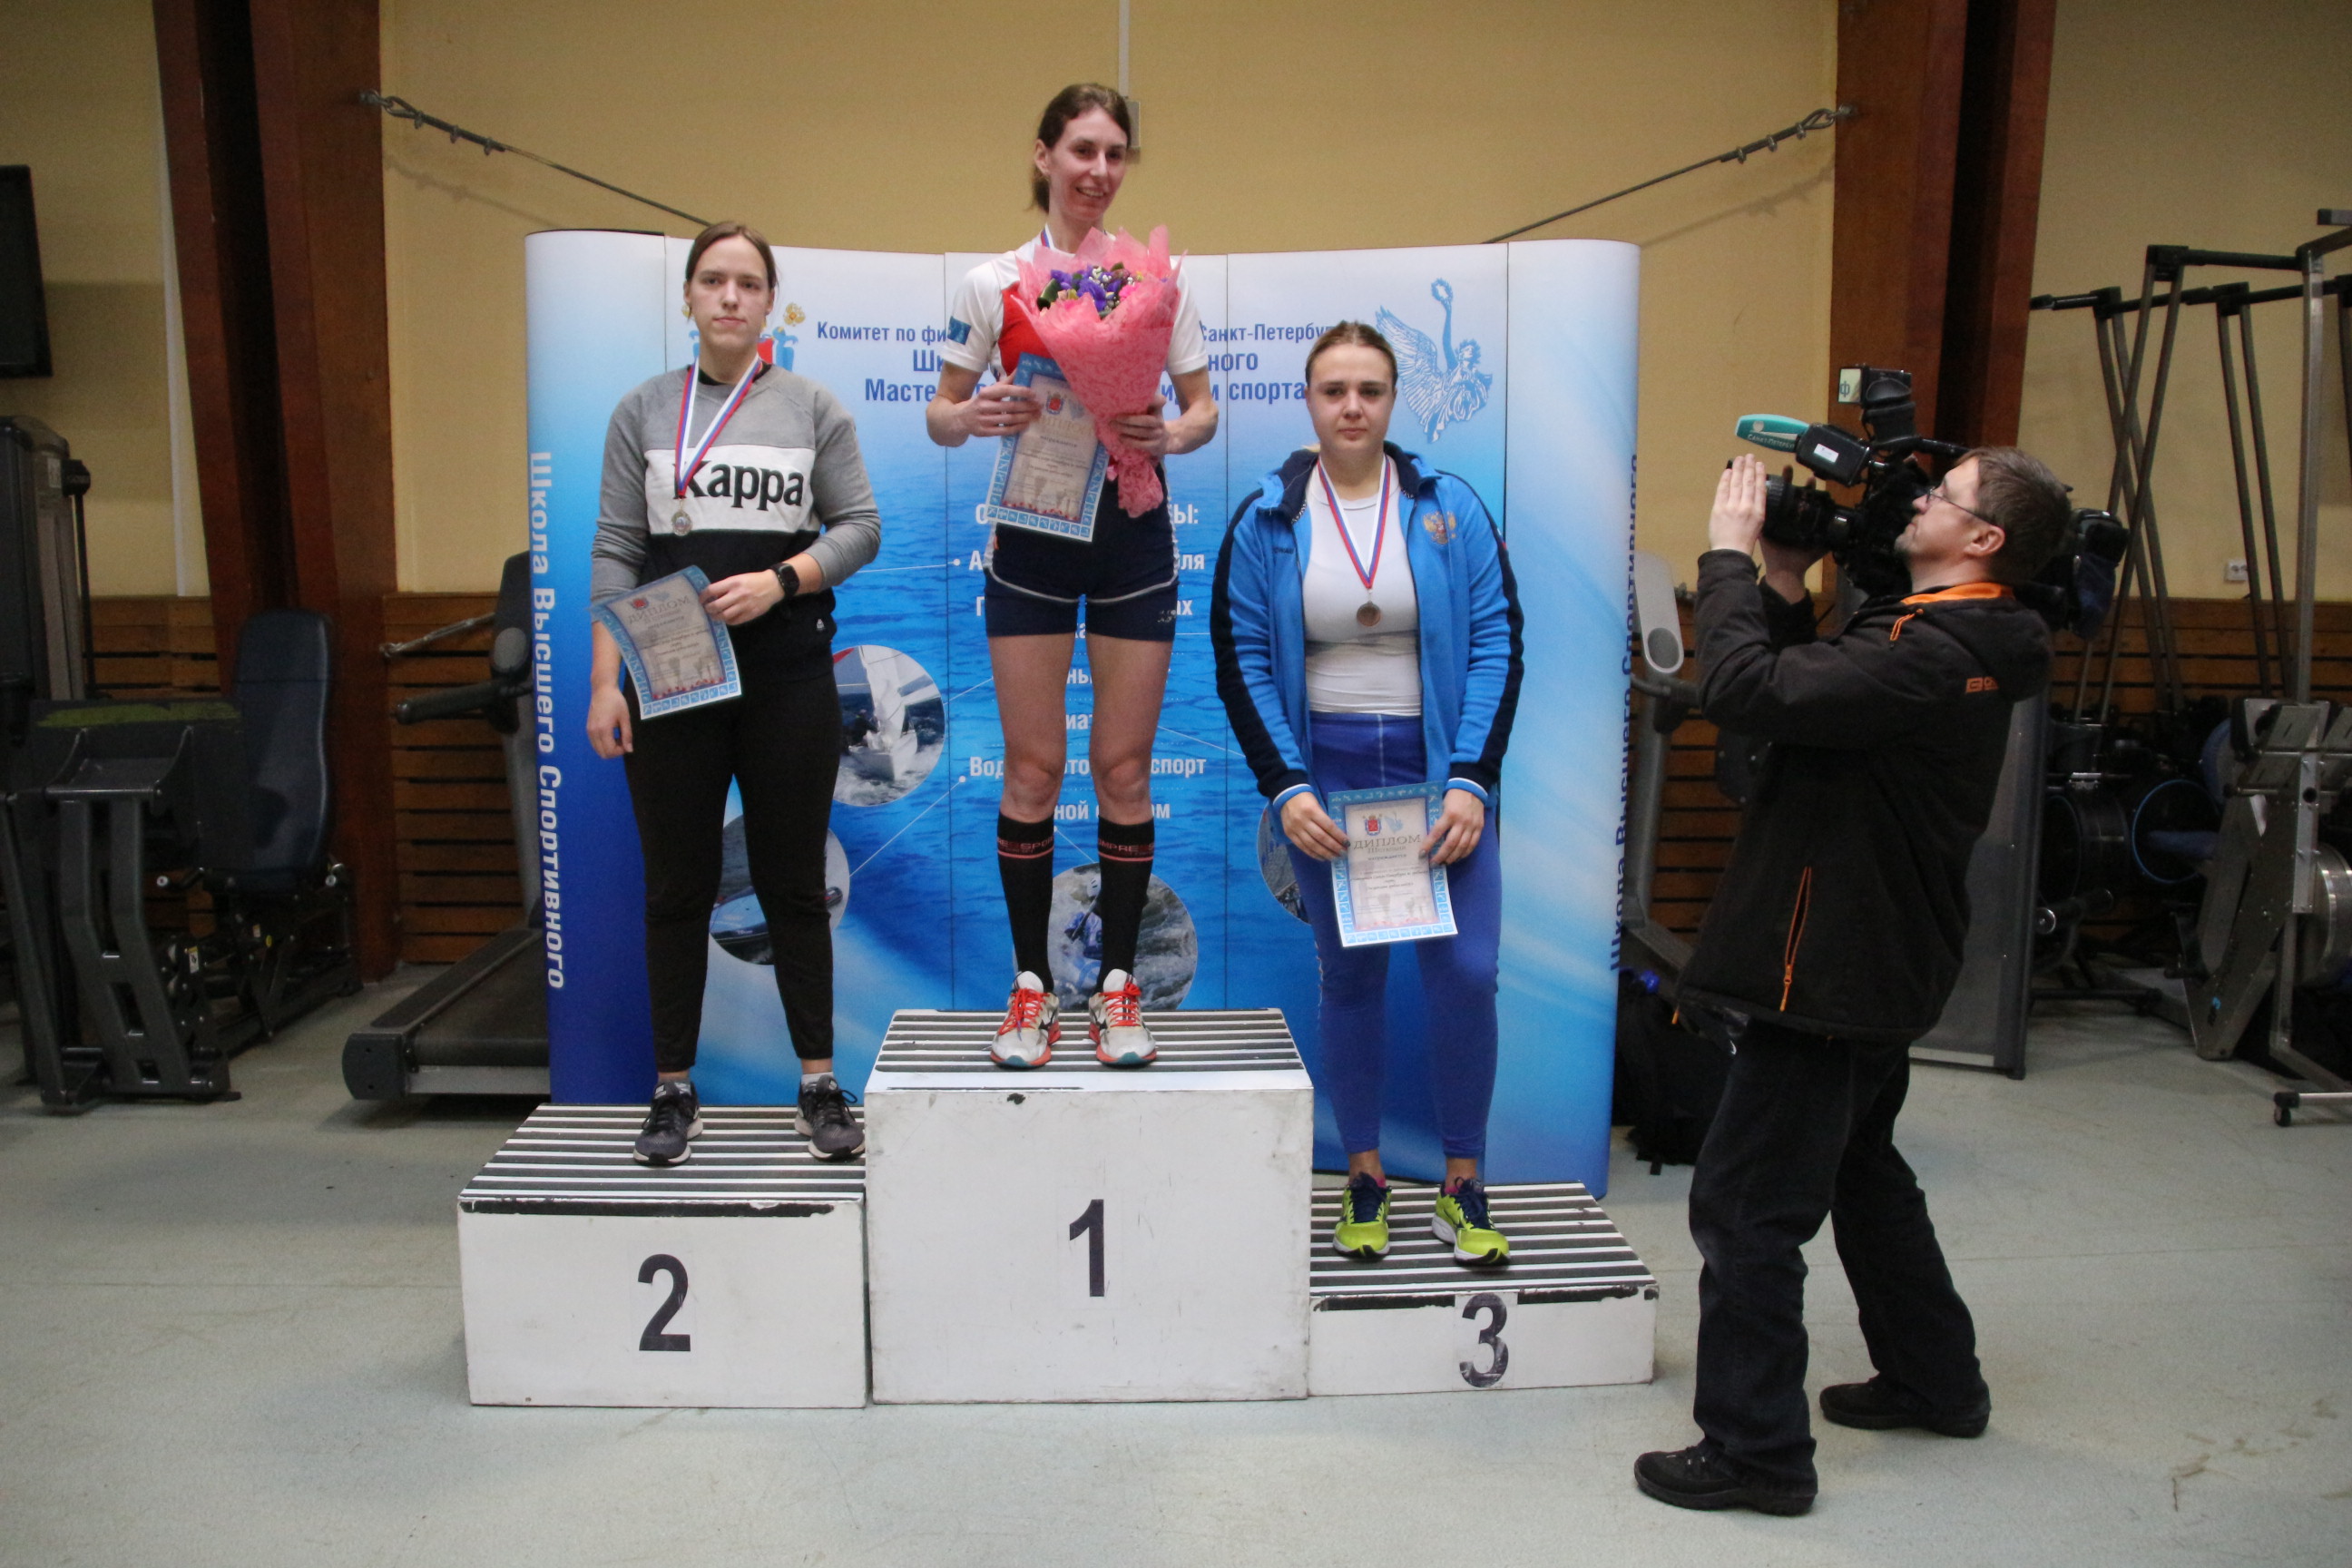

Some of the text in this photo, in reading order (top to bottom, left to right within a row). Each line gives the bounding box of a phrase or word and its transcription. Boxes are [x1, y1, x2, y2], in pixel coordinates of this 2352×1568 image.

[818, 321, 889, 341] Комитет
[896, 328, 916, 342] по
[865, 378, 936, 402] Масте
[1229, 382, 1305, 405] спорта
[672, 460, 805, 511] Kappa
[530, 452, 564, 989] Школа Высшего Спортивного
[1354, 834, 1422, 851] ДИПЛОМ
[1069, 1199, 1105, 1298] 1
[637, 1253, 691, 1352] 2
[1459, 1293, 1509, 1387] 3
